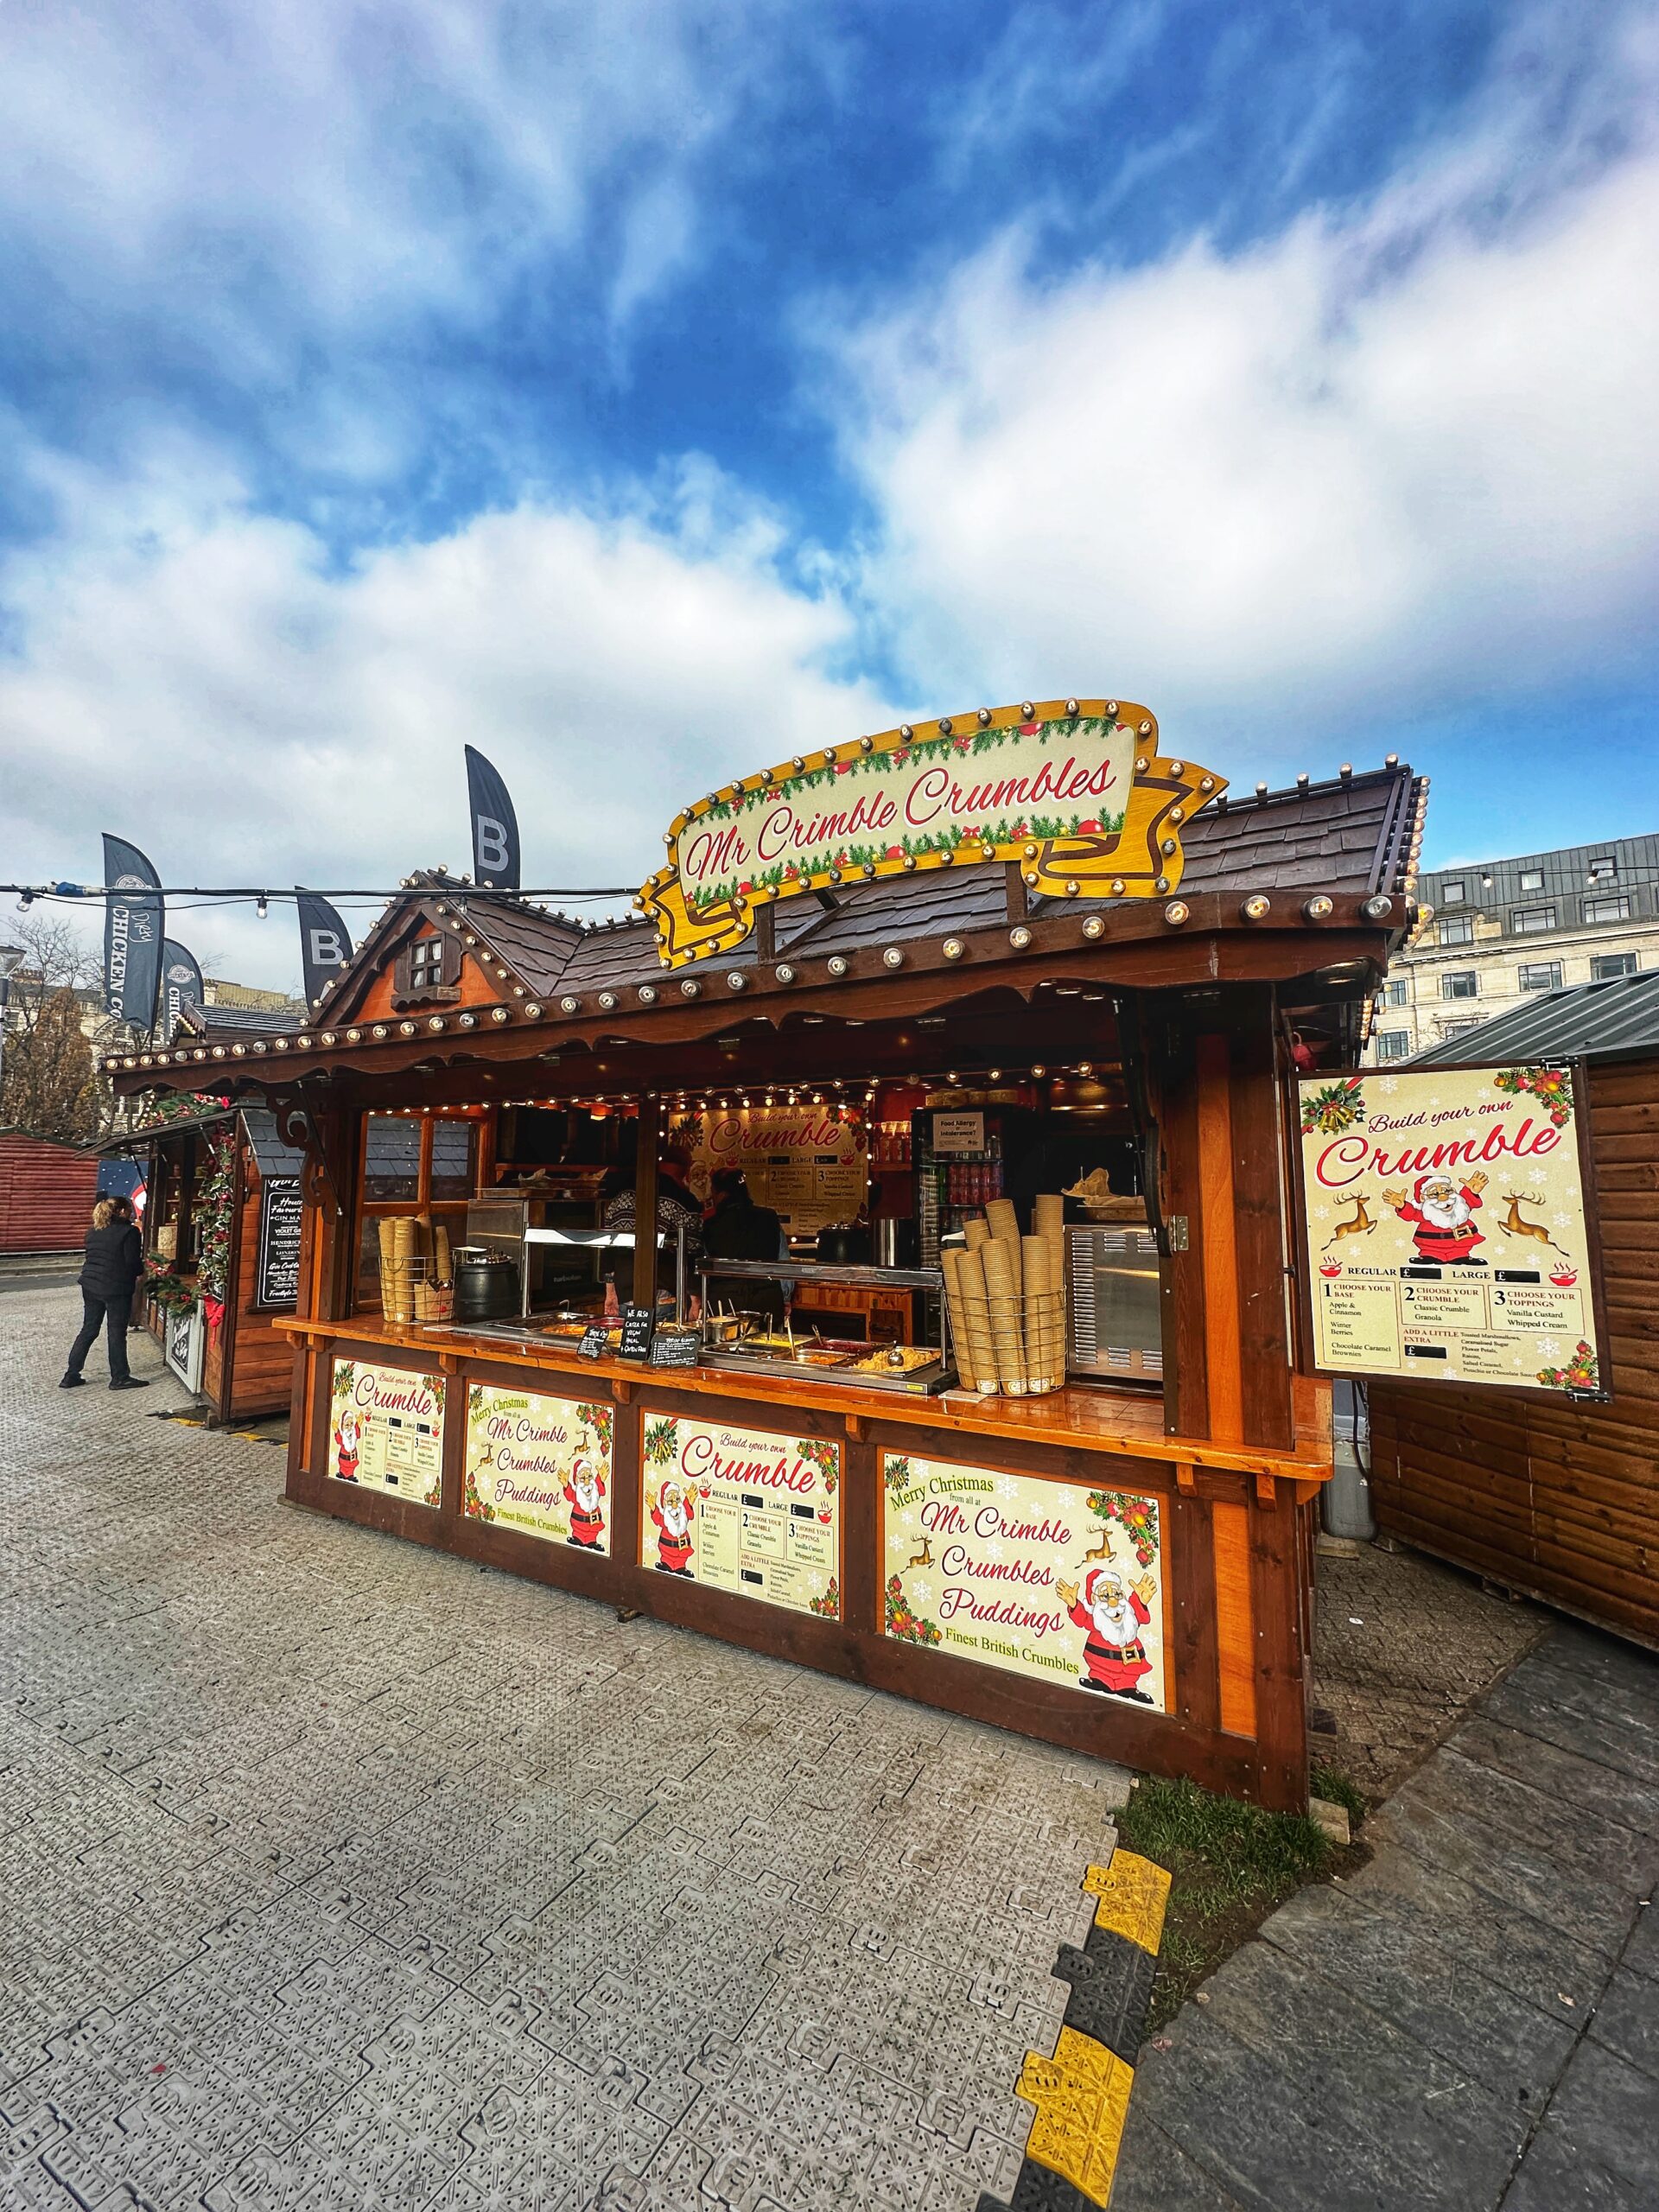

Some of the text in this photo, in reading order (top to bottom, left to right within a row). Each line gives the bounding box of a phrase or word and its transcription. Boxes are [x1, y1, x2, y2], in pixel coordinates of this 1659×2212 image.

[686, 758, 1116, 880] Mr Crimble Crumbles
[478, 814, 509, 872] B
[111, 906, 130, 993] CHICKEN
[310, 929, 344, 965] B
[747, 1112, 776, 1123] Build
[778, 1114, 798, 1123] your
[1369, 1100, 1513, 1133] Build your own
[709, 1118, 841, 1154] Crumble
[1317, 1118, 1561, 1186] Crumble
[1452, 1271, 1491, 1280] LARGE
[1324, 1283, 1332, 1297] 1
[1404, 1287, 1414, 1301] 2
[1494, 1290, 1505, 1306] 3
[1508, 1319, 1541, 1328] Whipped
[355, 1374, 432, 1414] Crumble
[471, 1397, 529, 1425] Merry Christmas
[487, 1417, 569, 1443] Mr Crimble
[720, 1433, 747, 1448] Build
[749, 1443, 769, 1452] your
[498, 1447, 557, 1473] Crumbles
[682, 1435, 817, 1493] Crumble
[494, 1479, 562, 1511] Puddings
[712, 1490, 739, 1501] REGULAR
[768, 1502, 788, 1511] LARGE
[890, 1475, 994, 1511] Merry Christmas
[950, 1493, 964, 1503] from
[965, 1496, 974, 1504] all
[498, 1508, 568, 1535] Finest British Crumbles
[743, 1513, 748, 1528] 2
[789, 1523, 795, 1538] 3
[921, 1502, 1072, 1544] Mr Crimble
[942, 1545, 1054, 1586] Crumbles
[939, 1588, 1065, 1638] Puddings
[945, 1628, 1079, 1675] Finest British Crumbles
